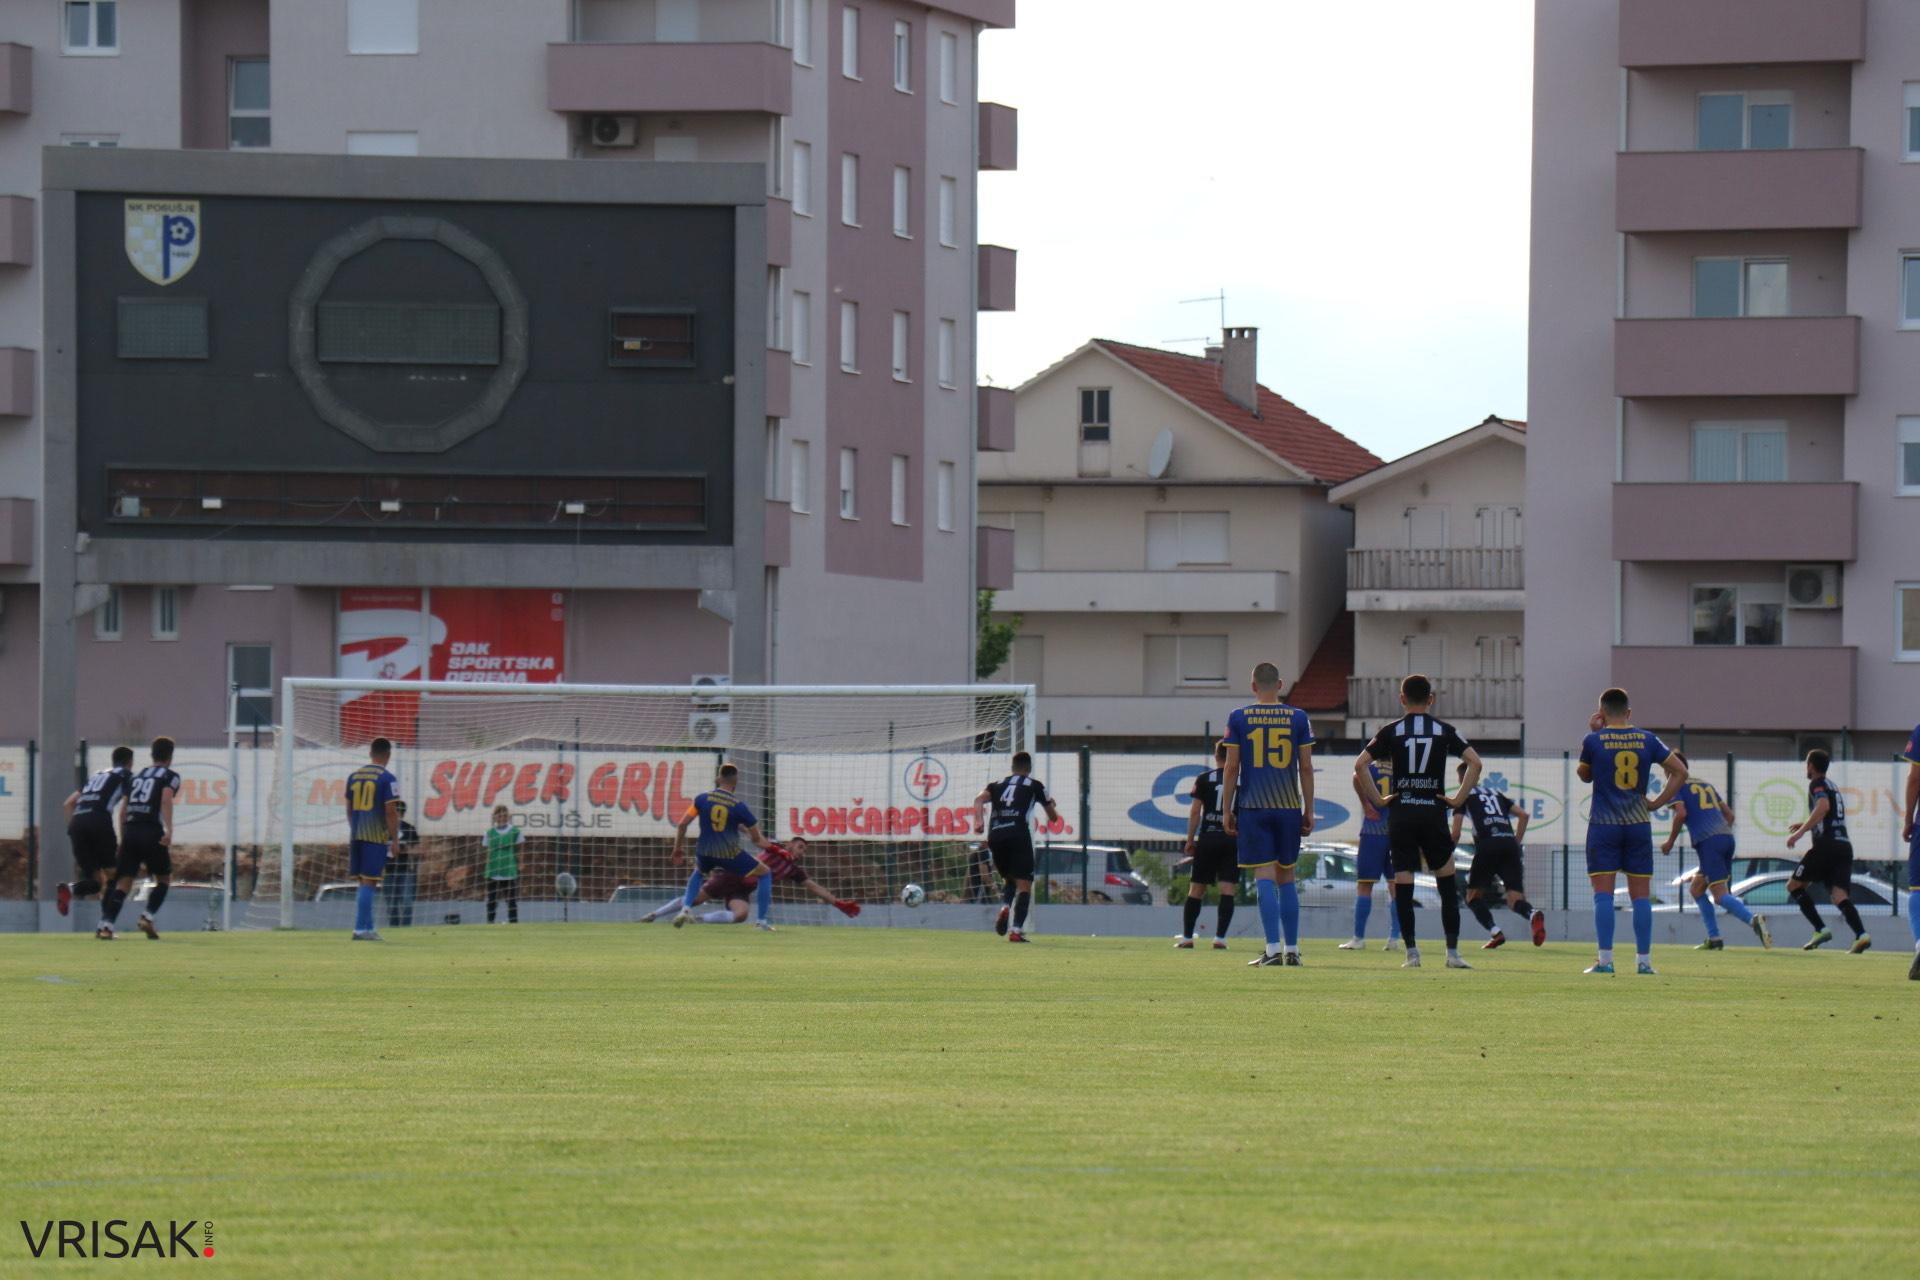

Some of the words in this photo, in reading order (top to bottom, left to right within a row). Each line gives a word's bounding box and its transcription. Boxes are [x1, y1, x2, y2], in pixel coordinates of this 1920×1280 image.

[447, 656, 555, 670] SPORTSKA
[444, 671, 528, 683] OPREMA
[1247, 727, 1292, 769] 15
[1404, 737, 1433, 774] 17
[1411, 777, 1439, 790] POSUŠJE
[1614, 751, 1639, 790] 8
[129, 777, 155, 804] 29
[350, 780, 376, 812] 10
[423, 760, 575, 821] SUPER
[588, 760, 694, 827] GRIL
[1000, 784, 1015, 806] 4
[710, 804, 728, 832] 9
[789, 797, 989, 836] LONČARPLAST
[1479, 793, 1504, 816] 31
[510, 810, 613, 829] OSUŠJE
